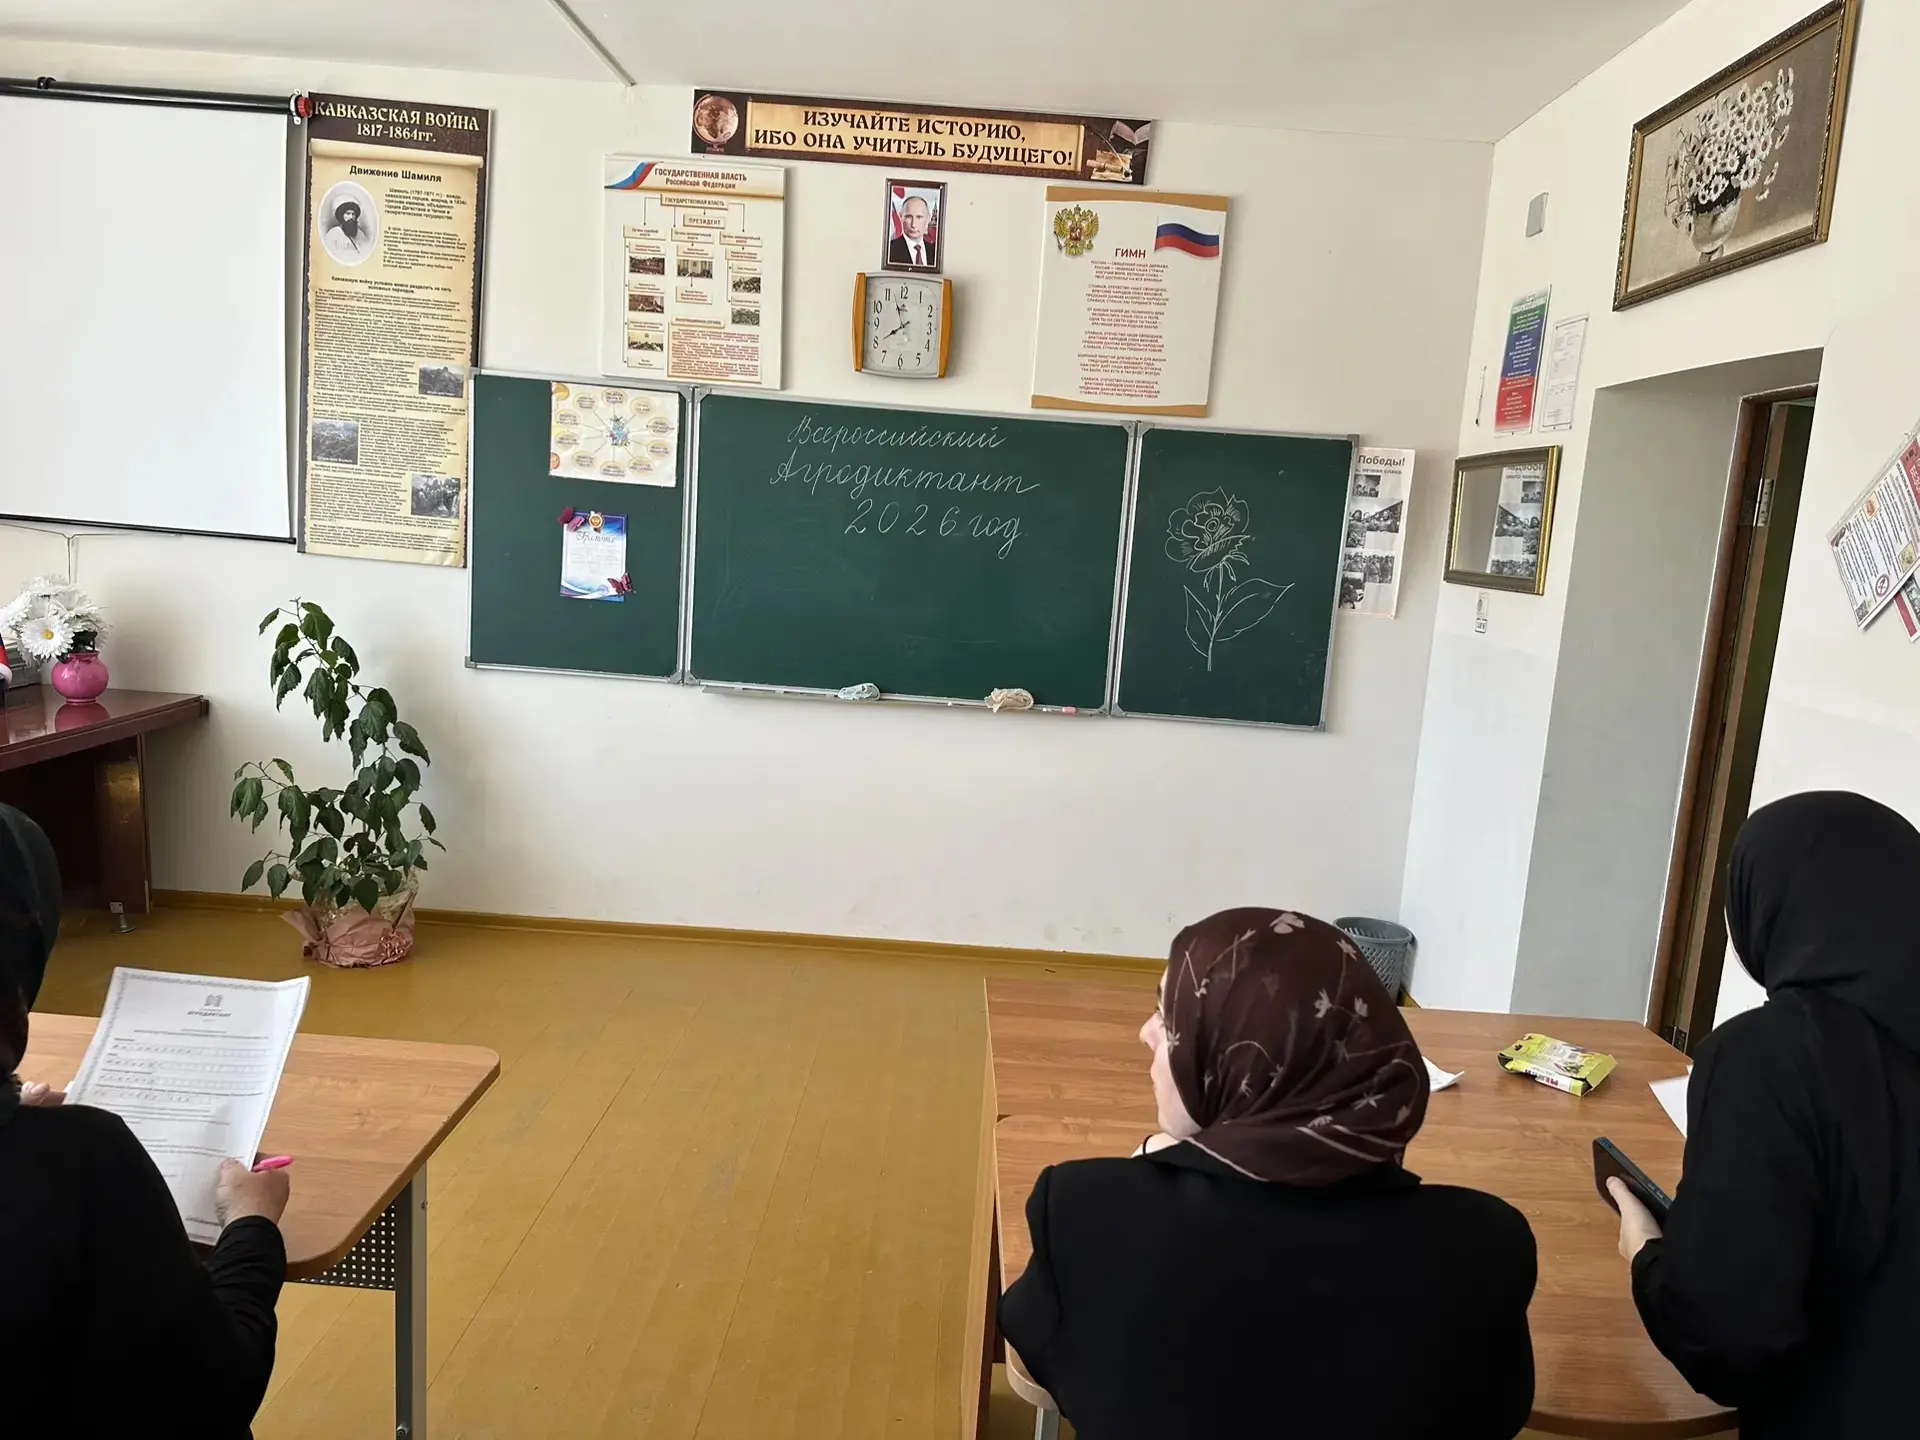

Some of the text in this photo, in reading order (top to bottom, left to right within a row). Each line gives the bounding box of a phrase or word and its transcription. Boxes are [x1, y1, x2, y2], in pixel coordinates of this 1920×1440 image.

[315, 101, 480, 131] КАВКАЗСКАЯ ВОЙНА
[357, 123, 437, 143] 1817-1864гг.
[803, 110, 1026, 144] ИЗУЧАЙТЕ ИСТОРИЮ,
[753, 129, 1073, 167] ИБО ОНА УЧИТЕЛЬ БУДУЩЕГО!
[349, 165, 442, 183] Движение Шамиля
[654, 167, 747, 182] ГОСУДАРСТВЕННАЯ ВЛАСТЬ
[688, 217, 721, 226] ПРЕЗИДЕНТ
[1115, 248, 1146, 258] ГИМН
[885, 288, 891, 301] 11
[900, 286, 909, 299] 12
[919, 290, 922, 304] 1
[873, 300, 883, 314] 10
[927, 304, 933, 318] 2
[873, 317, 880, 330] 9
[926, 322, 932, 335] 3
[873, 336, 879, 349] 8
[924, 339, 930, 352] 4
[881, 350, 887, 363] 7
[897, 353, 903, 368] 6
[915, 353, 921, 367] 5
[787, 415, 1007, 453] Всероссийский
[1358, 454, 1405, 467] Победы!
[769, 446, 1041, 499] Агродиктант
[844, 498, 1023, 560] 2026 год
